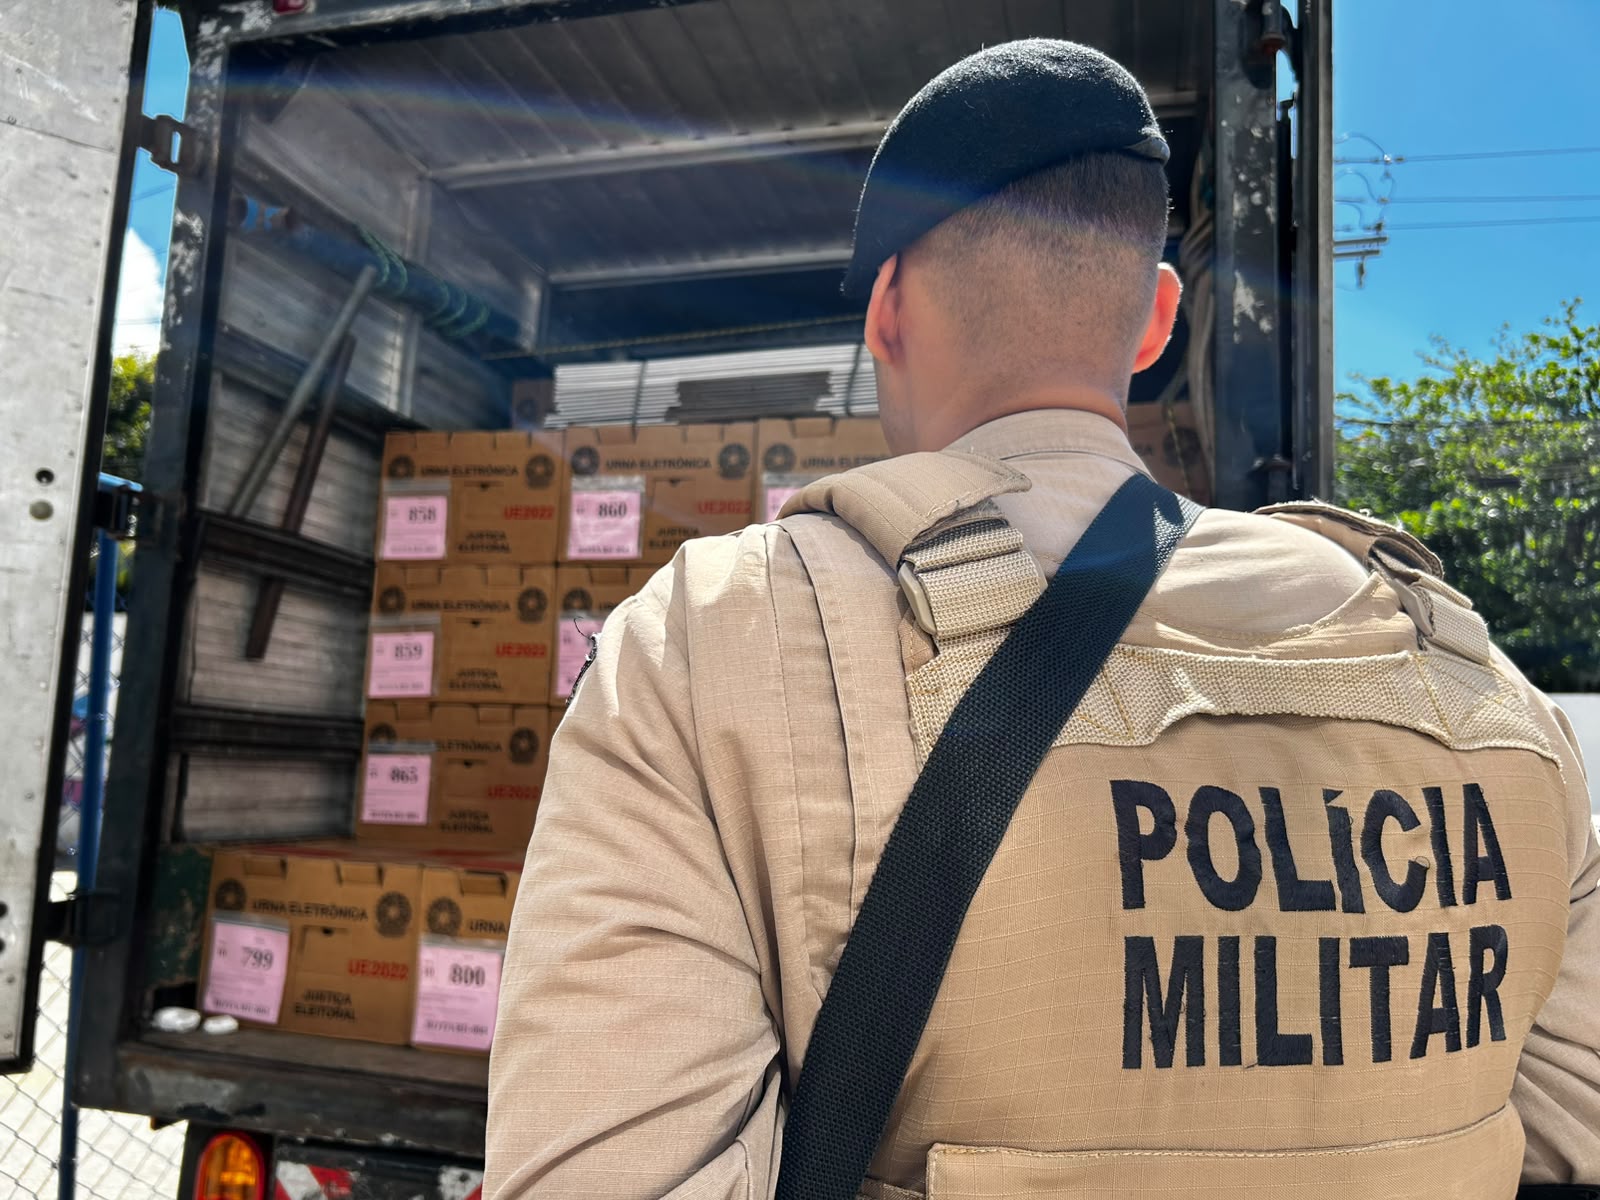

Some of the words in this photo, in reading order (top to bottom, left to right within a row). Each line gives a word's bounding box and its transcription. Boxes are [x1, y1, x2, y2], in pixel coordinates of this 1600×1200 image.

[606, 458, 636, 470] URNA
[504, 505, 554, 520] UE2022
[598, 502, 628, 519] 860
[698, 500, 752, 514] UE2022
[1110, 779, 1512, 914] POLÍCIA
[252, 900, 287, 914] URNA
[288, 902, 368, 920] ELETRÔNICA
[468, 918, 508, 934] URNA
[241, 945, 275, 970] 799
[347, 958, 409, 981] UE2022
[450, 962, 487, 988] 800
[1122, 924, 1508, 1069] MILITAR
